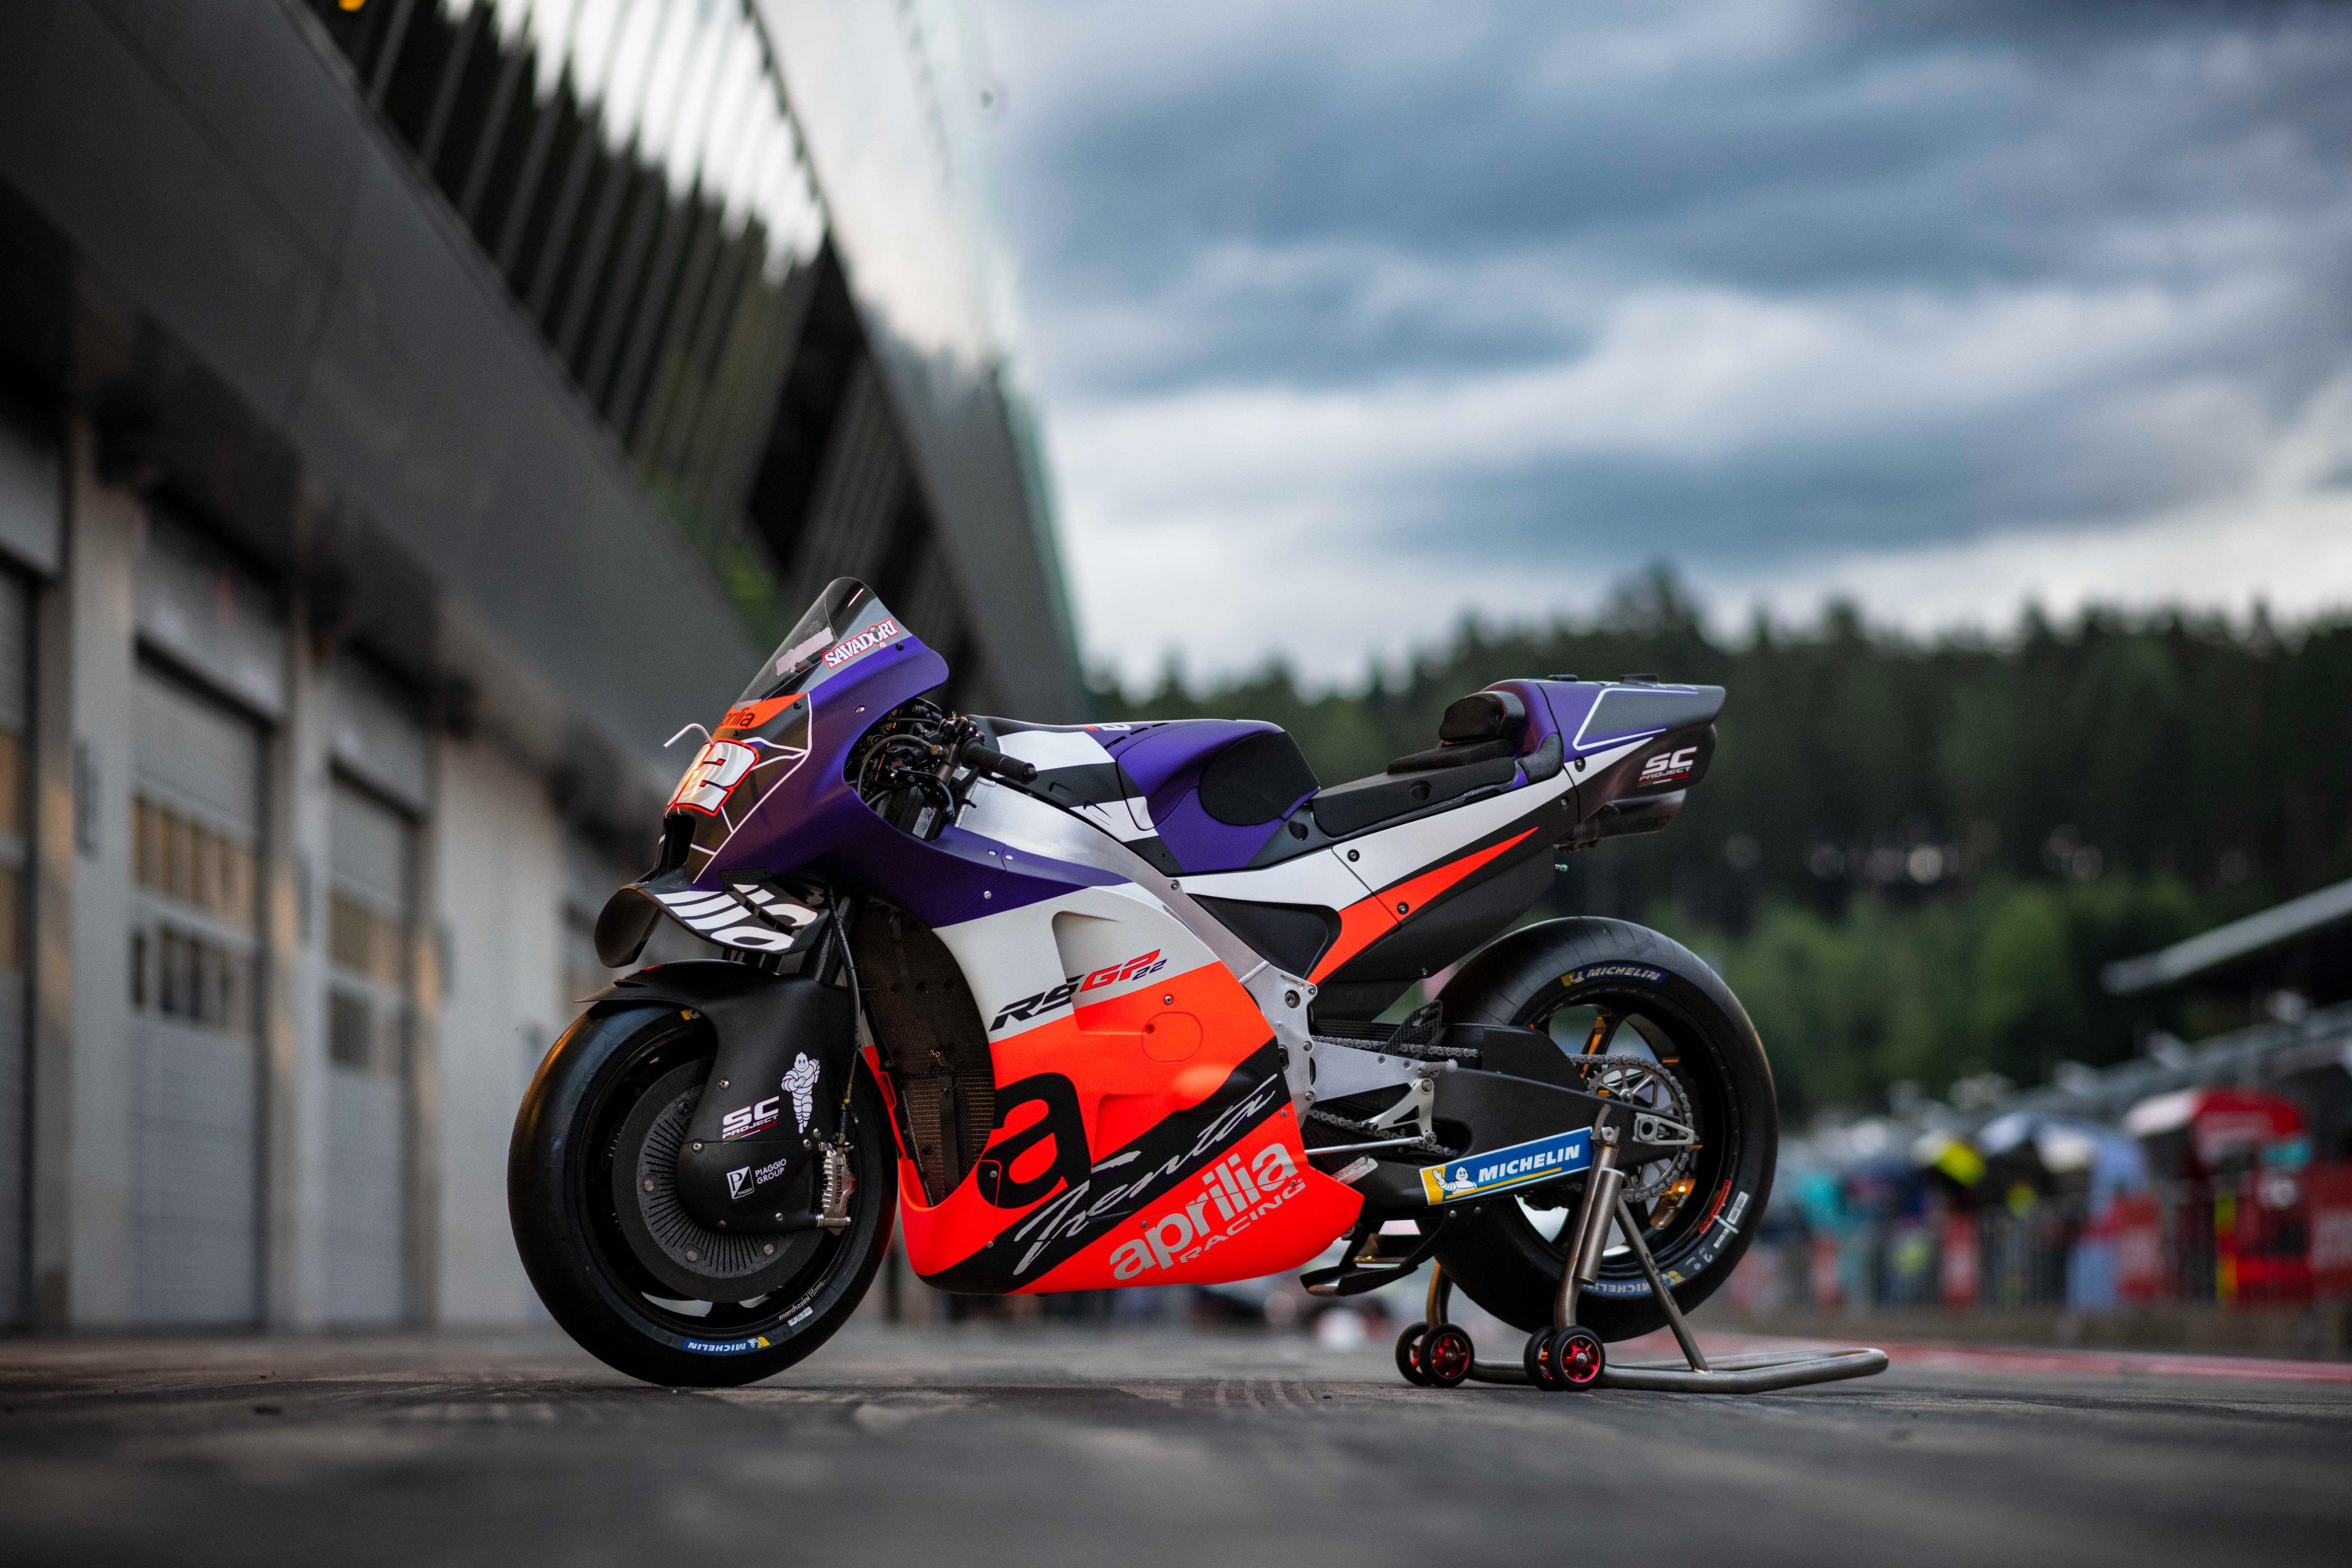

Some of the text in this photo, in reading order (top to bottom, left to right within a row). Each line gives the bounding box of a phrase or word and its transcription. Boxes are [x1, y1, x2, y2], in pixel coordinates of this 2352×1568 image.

[823, 620, 899, 667] SAVADORI
[1639, 765, 1691, 781] PROJECT
[1642, 746, 1697, 776] SC
[1587, 966, 1661, 981] MICHELIN
[722, 1095, 779, 1133] SC
[722, 1114, 779, 1139] PROJECT
[755, 1159, 787, 1178] PIAGGIO
[757, 1167, 784, 1184] GROUP
[1478, 1144, 1580, 1183] MICHELIN
[738, 1187, 752, 1195] PIAGGIO
[835, 1164, 844, 1204] brembo
[1109, 1143, 1298, 1280] aprilia
[1179, 1178, 1306, 1264] RACING
[1583, 1282, 1652, 1293] MICHELI
[779, 1294, 810, 1321] marchesini
[688, 1342, 746, 1352] MICHELIN
